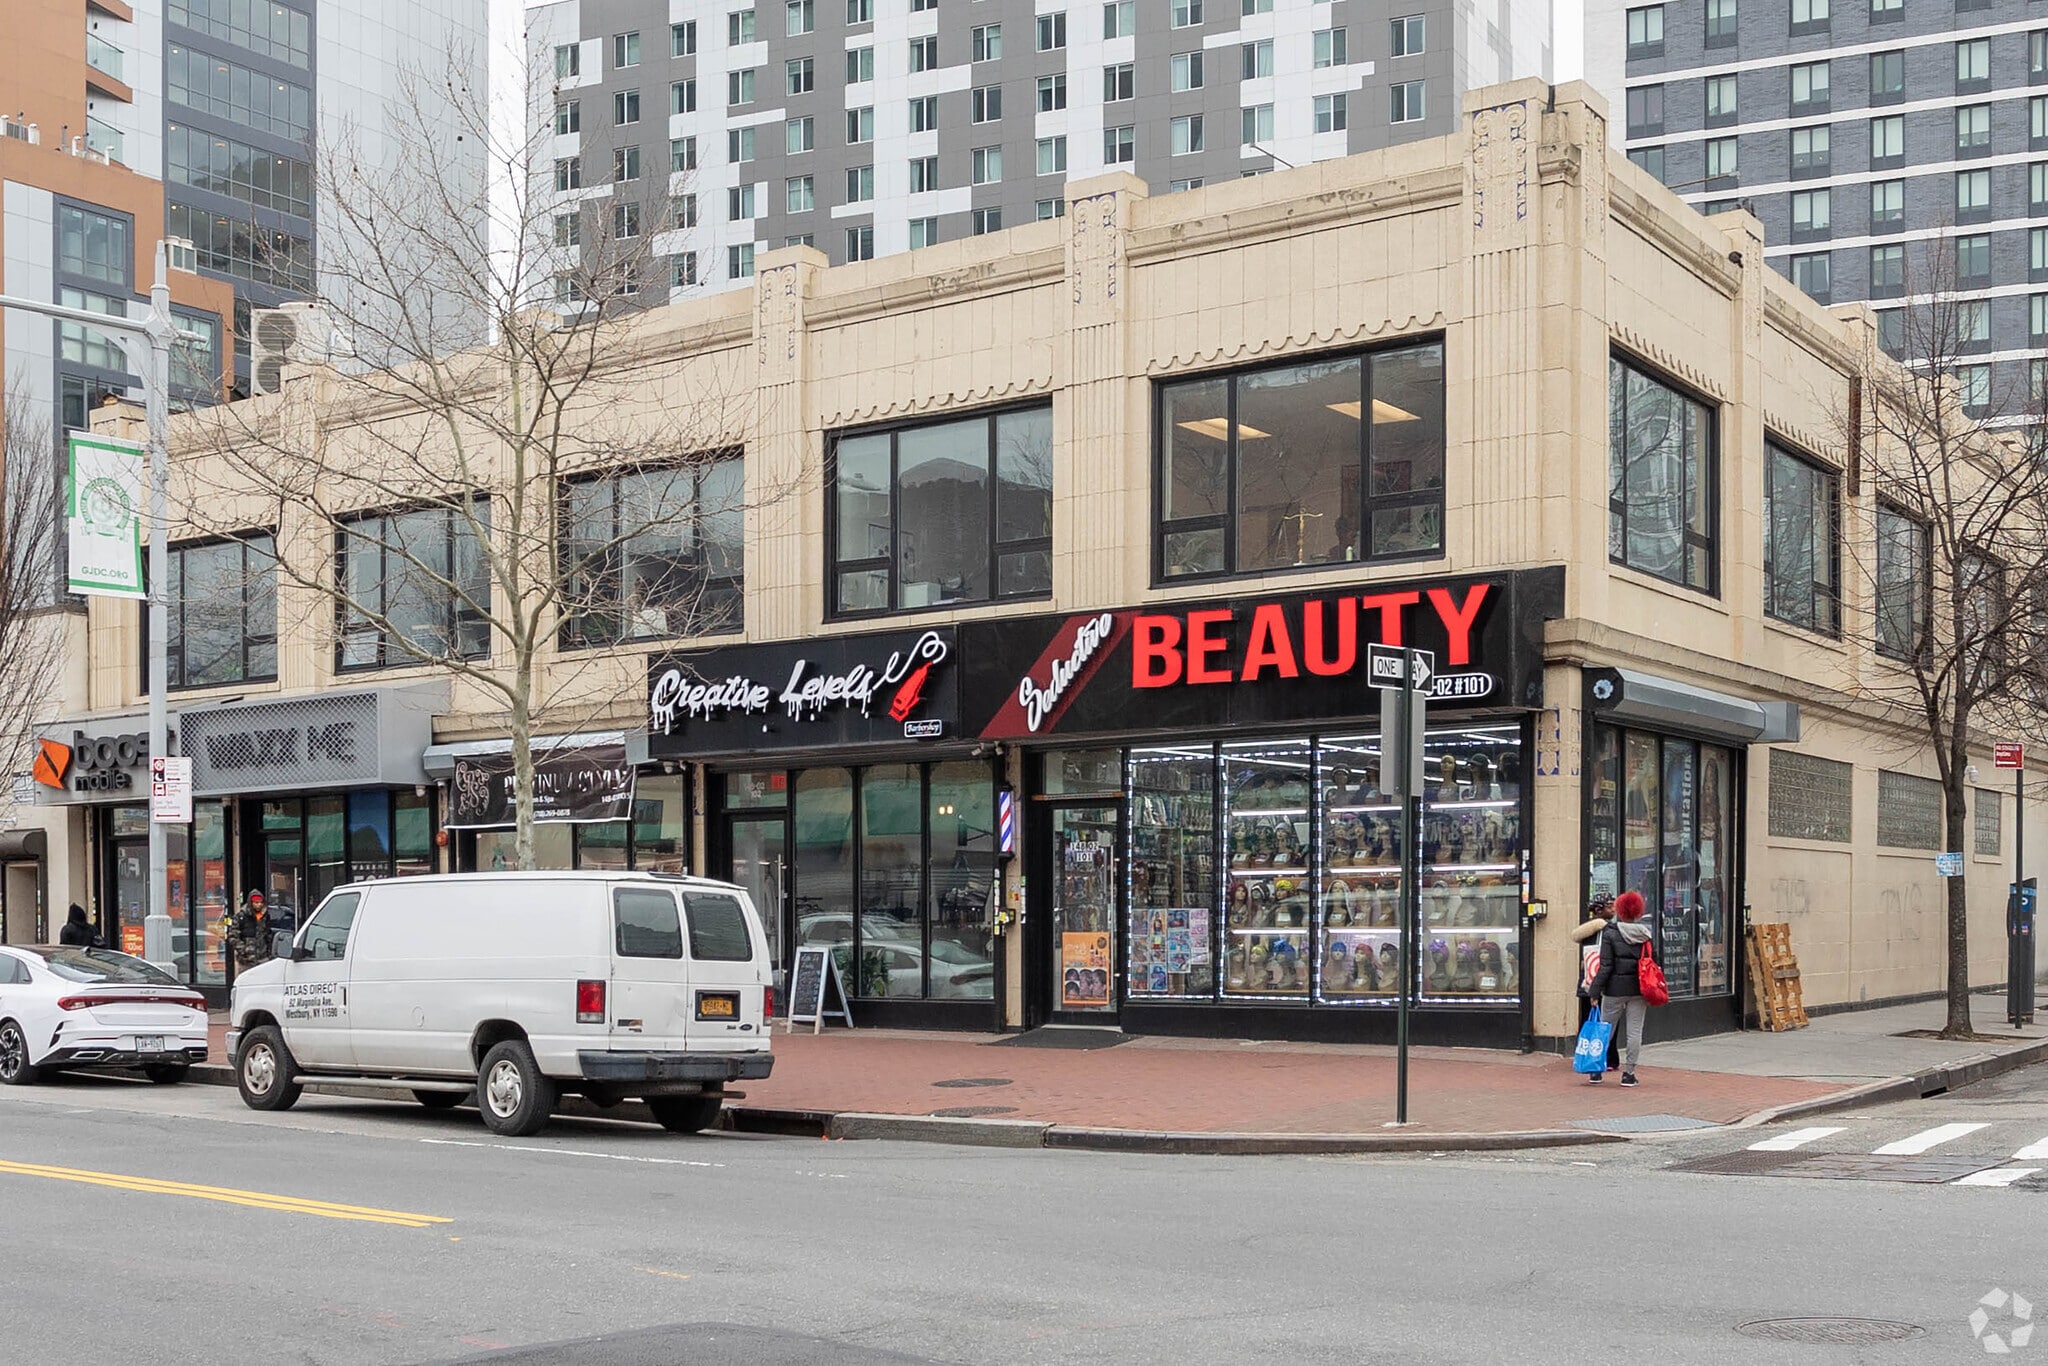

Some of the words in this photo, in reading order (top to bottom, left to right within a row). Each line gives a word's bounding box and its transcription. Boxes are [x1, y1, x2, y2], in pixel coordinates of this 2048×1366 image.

[81, 566, 129, 579] GJDC.ORG
[1132, 584, 1490, 688] BEAUTY
[1019, 613, 1112, 733] Seductive
[1377, 659, 1397, 675] ONE
[1455, 676, 1484, 695] #101
[651, 669, 770, 733] Creative
[779, 659, 876, 720] Levels
[74, 726, 175, 770] boos
[75, 769, 132, 791] mobile
[284, 985, 308, 996] ATLAS
[310, 983, 337, 995] DIRECT
[313, 1008, 320, 1017] NY
